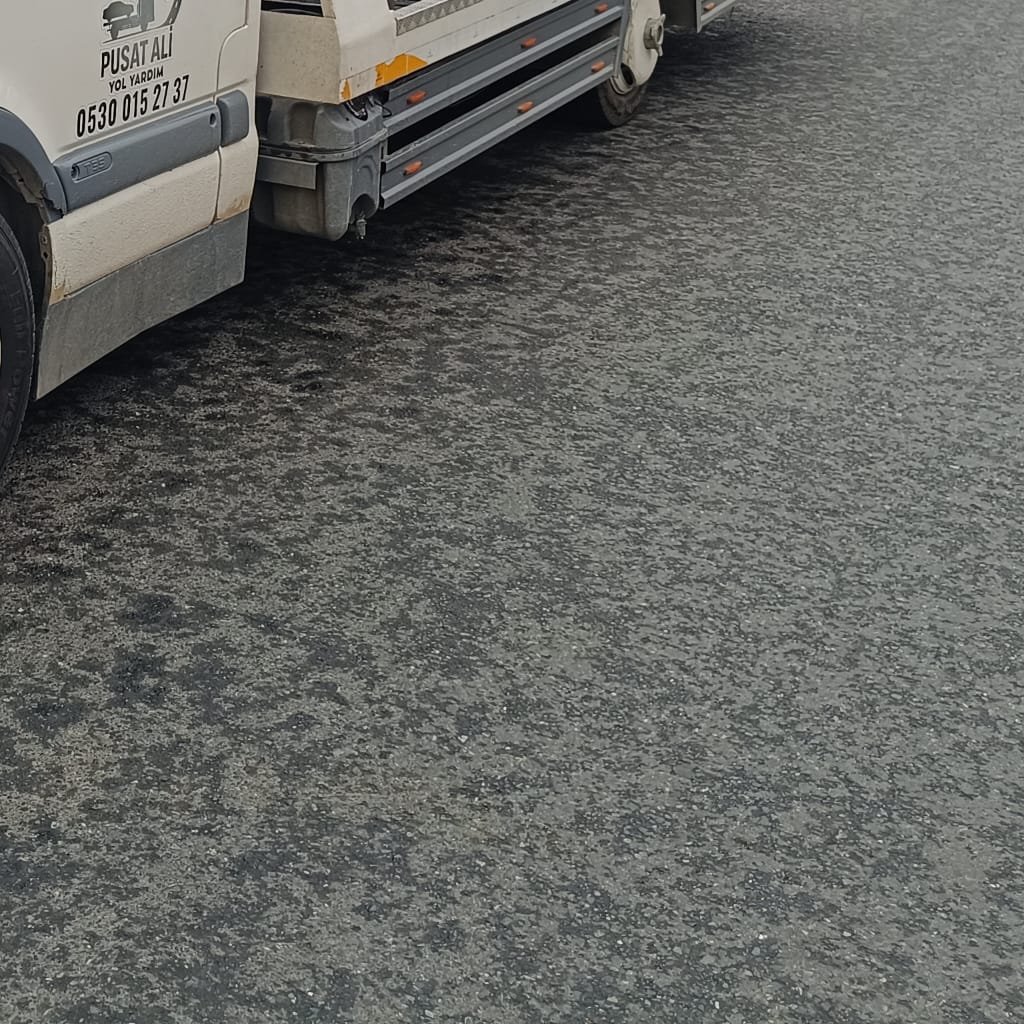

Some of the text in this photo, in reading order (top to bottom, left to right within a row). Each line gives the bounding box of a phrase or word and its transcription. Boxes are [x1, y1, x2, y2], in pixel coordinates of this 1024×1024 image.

[101, 25, 173, 78] PUSAT ALİ
[76, 74, 190, 137] 0530 015 27 37
[109, 66, 164, 93] YOL YARDIM
